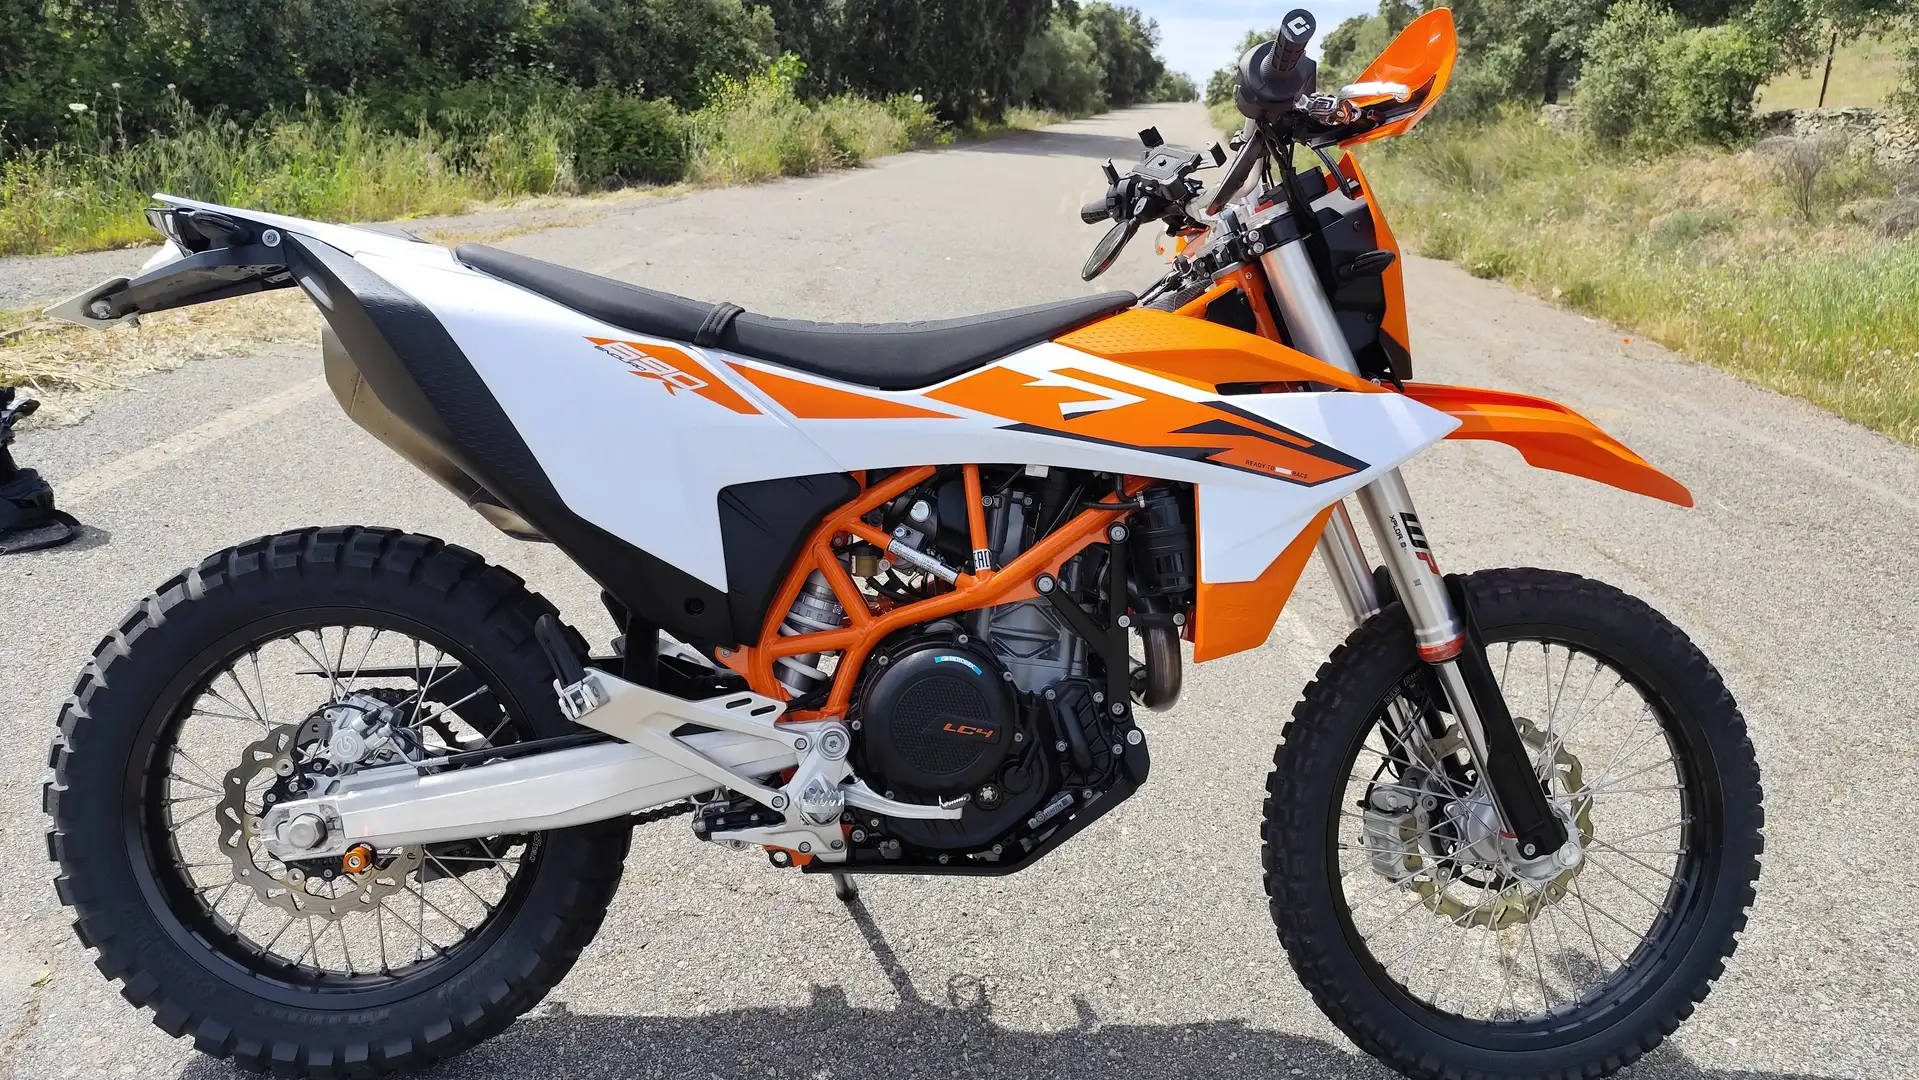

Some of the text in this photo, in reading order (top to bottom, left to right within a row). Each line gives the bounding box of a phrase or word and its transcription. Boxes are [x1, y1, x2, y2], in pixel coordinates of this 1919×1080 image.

[1245, 460, 1266, 468] READY
[1291, 471, 1308, 479] RACE
[1399, 512, 1439, 575] WP
[943, 723, 993, 738] LC4
